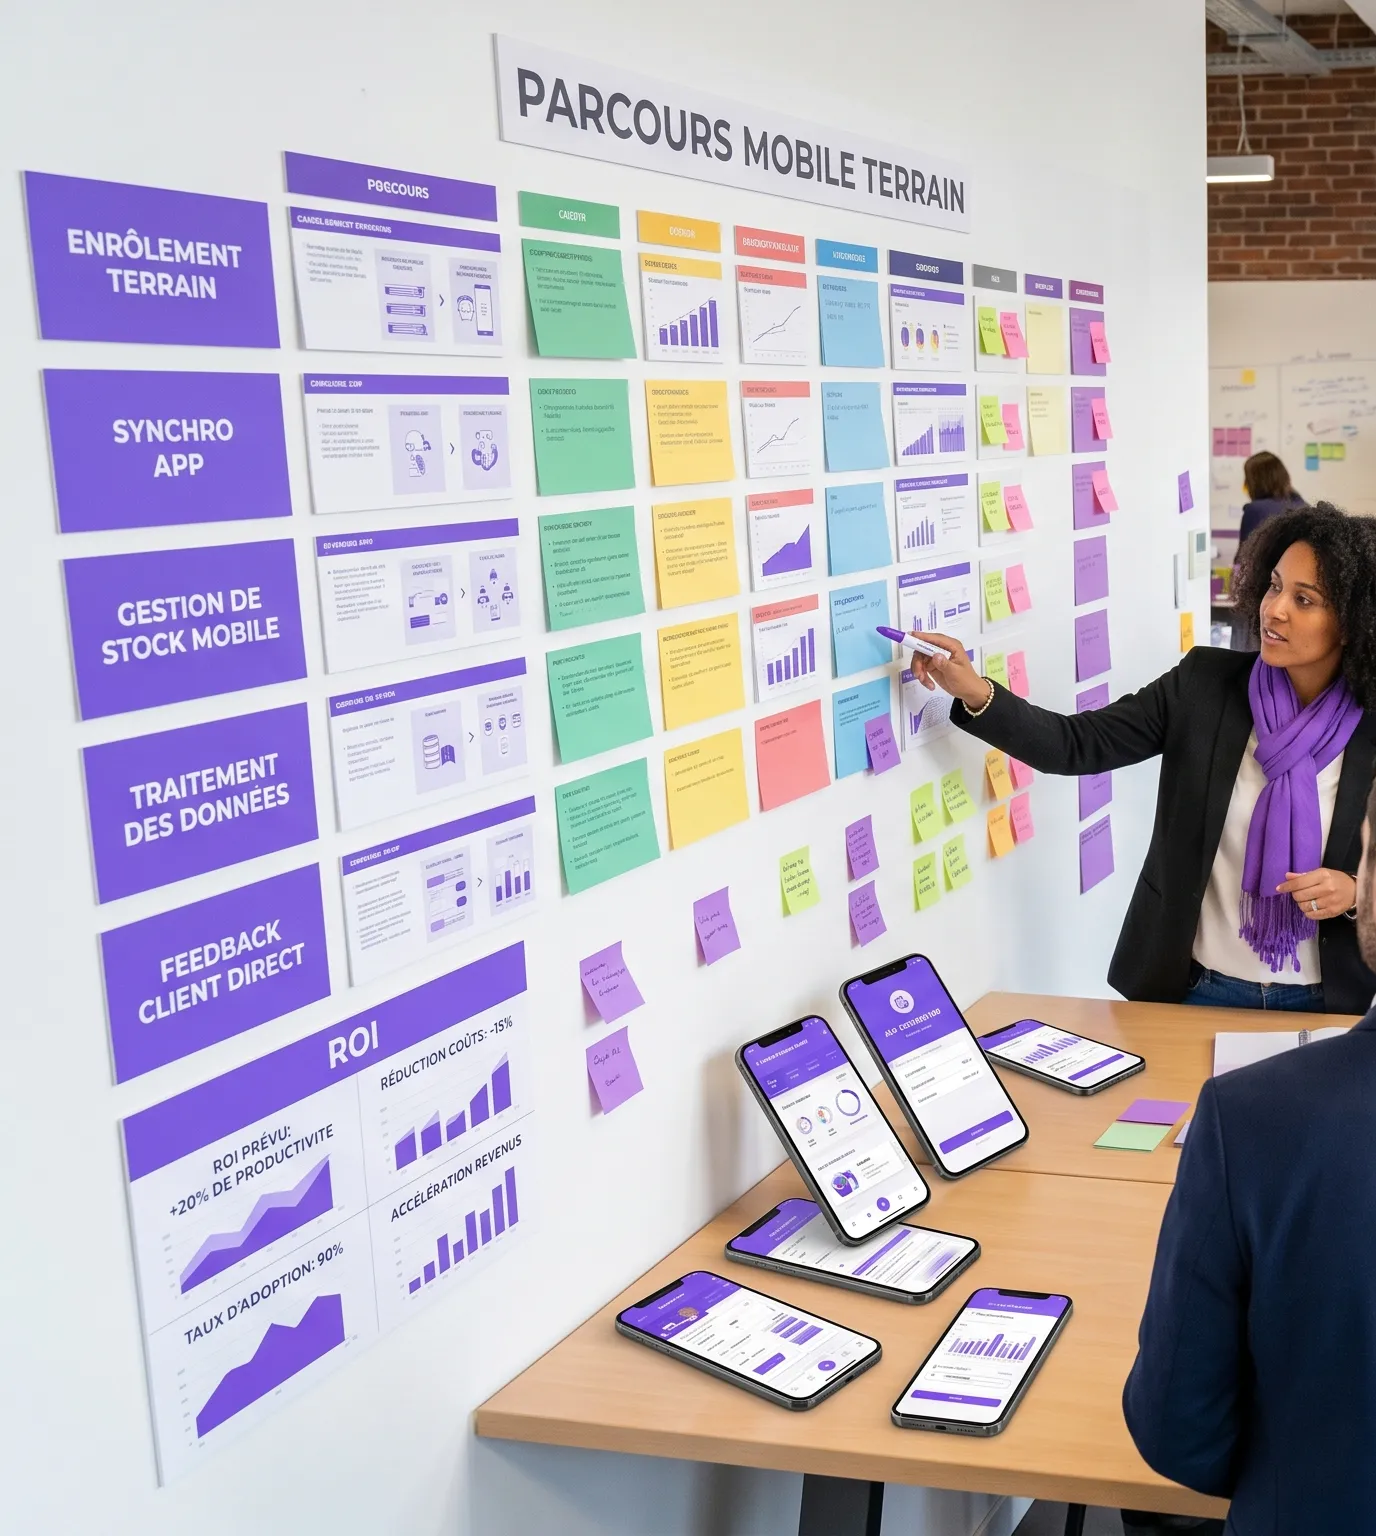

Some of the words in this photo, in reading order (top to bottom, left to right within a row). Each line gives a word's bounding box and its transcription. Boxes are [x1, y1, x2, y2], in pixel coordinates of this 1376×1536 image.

[517, 67, 733, 162] PARCOURS
[743, 125, 856, 190] MOBILE
[862, 157, 965, 214] TERRAIN
[67, 228, 242, 268] ENRÔLEMENT
[106, 268, 217, 299] TERRAIN
[112, 418, 234, 444] SYNCHRO
[153, 453, 204, 478] APP
[117, 591, 224, 627] GESTION
[230, 587, 262, 612] DE
[101, 630, 187, 665] STOCK
[191, 617, 280, 651] MOBILE
[129, 753, 278, 810] TRAITEMENT
[124, 813, 174, 847] DES
[179, 782, 290, 832] DONNÉES
[160, 919, 282, 983] FEEDBACK
[138, 974, 222, 1025] CLIENT
[228, 943, 305, 992] DIRECT
[328, 1020, 379, 1069] ROI
[380, 1047, 446, 1091] RÉDUCTION
[448, 1029, 487, 1056] COÛTS:
[489, 1015, 513, 1034] -15%
[213, 1150, 239, 1174] ROI
[242, 1125, 291, 1160] PRÉVU:
[169, 1188, 209, 1217] +20%
[212, 1176, 233, 1197] DE
[390, 1163, 473, 1223] ACCÉLÉRATION
[475, 1134, 522, 1172] REVENUS
[184, 1311, 224, 1345] TAUX
[317, 1241, 344, 1267] 90%
